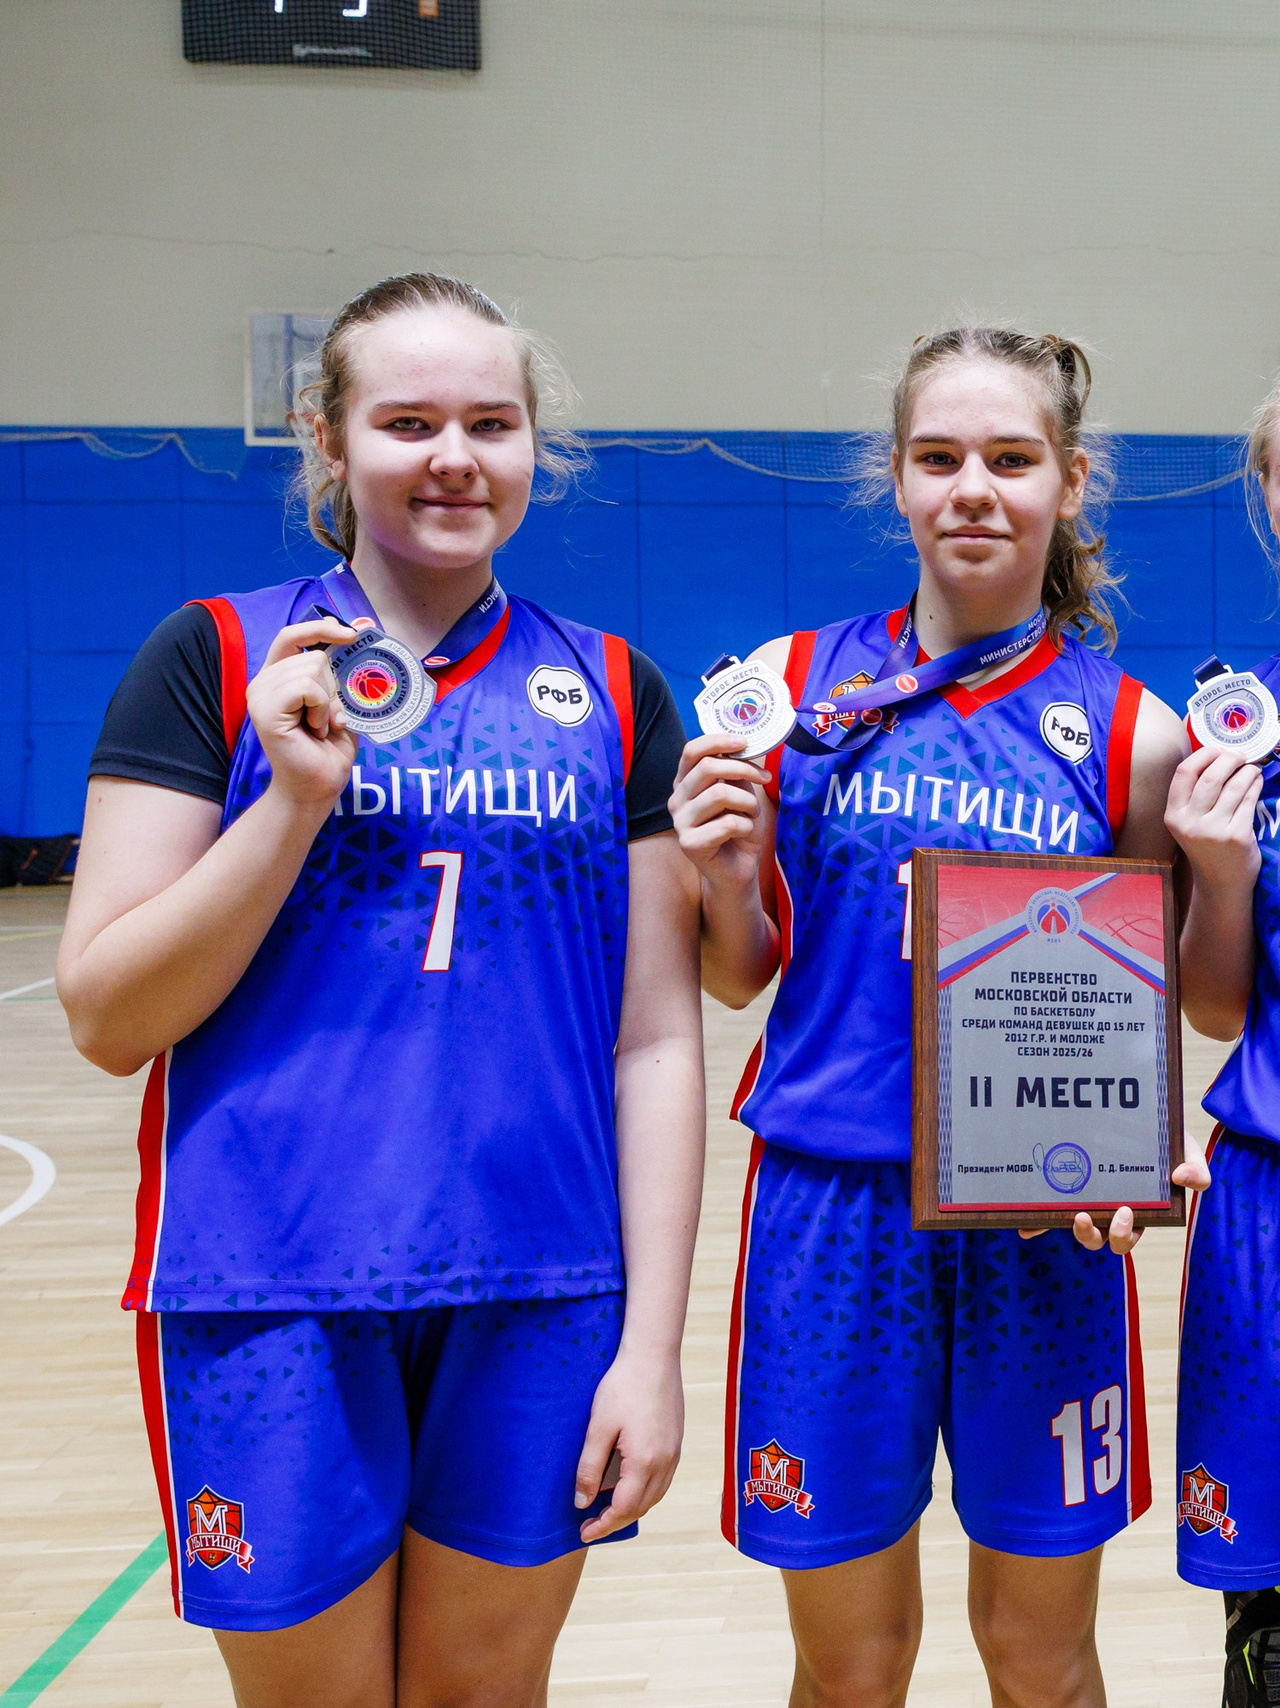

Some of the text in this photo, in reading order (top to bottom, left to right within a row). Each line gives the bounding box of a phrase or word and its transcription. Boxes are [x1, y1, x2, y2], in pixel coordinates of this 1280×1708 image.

[344, 634, 374, 657] МЕСТО
[979, 626, 1042, 665] МИНИСТЕРСТВО
[536, 685, 584, 705] РФБ
[702, 666, 760, 705] ВТОРОЕ МЕСТО
[1194, 678, 1251, 708] ВТОРОЕ МЕСТО
[334, 765, 577, 827] ЫТИЩИ
[822, 771, 1082, 854] МЫТИЩИ
[1010, 971, 1098, 986] ПЕРВЕНСТВО
[974, 986, 1133, 1004] МОСКОВСКОЙ ОБЛАСТИ
[1013, 1006, 1096, 1018] ПО БАСКЕТБОЛУ
[961, 1018, 1146, 1032] СРЕДИ КОМАНД ДЕВУШЕК ДО 15 ЛЕТ
[1004, 1033, 1105, 1044] 2012 Г.Р. И МОЛОЖЕ
[1017, 1047, 1093, 1057] СЕЗОН 2025/26
[969, 1076, 1140, 1109] II МЕСТО
[957, 1164, 1034, 1174] Президент МОФБ
[1098, 1164, 1155, 1174] О. Д. Беликов
[1050, 1383, 1123, 1507] 13
